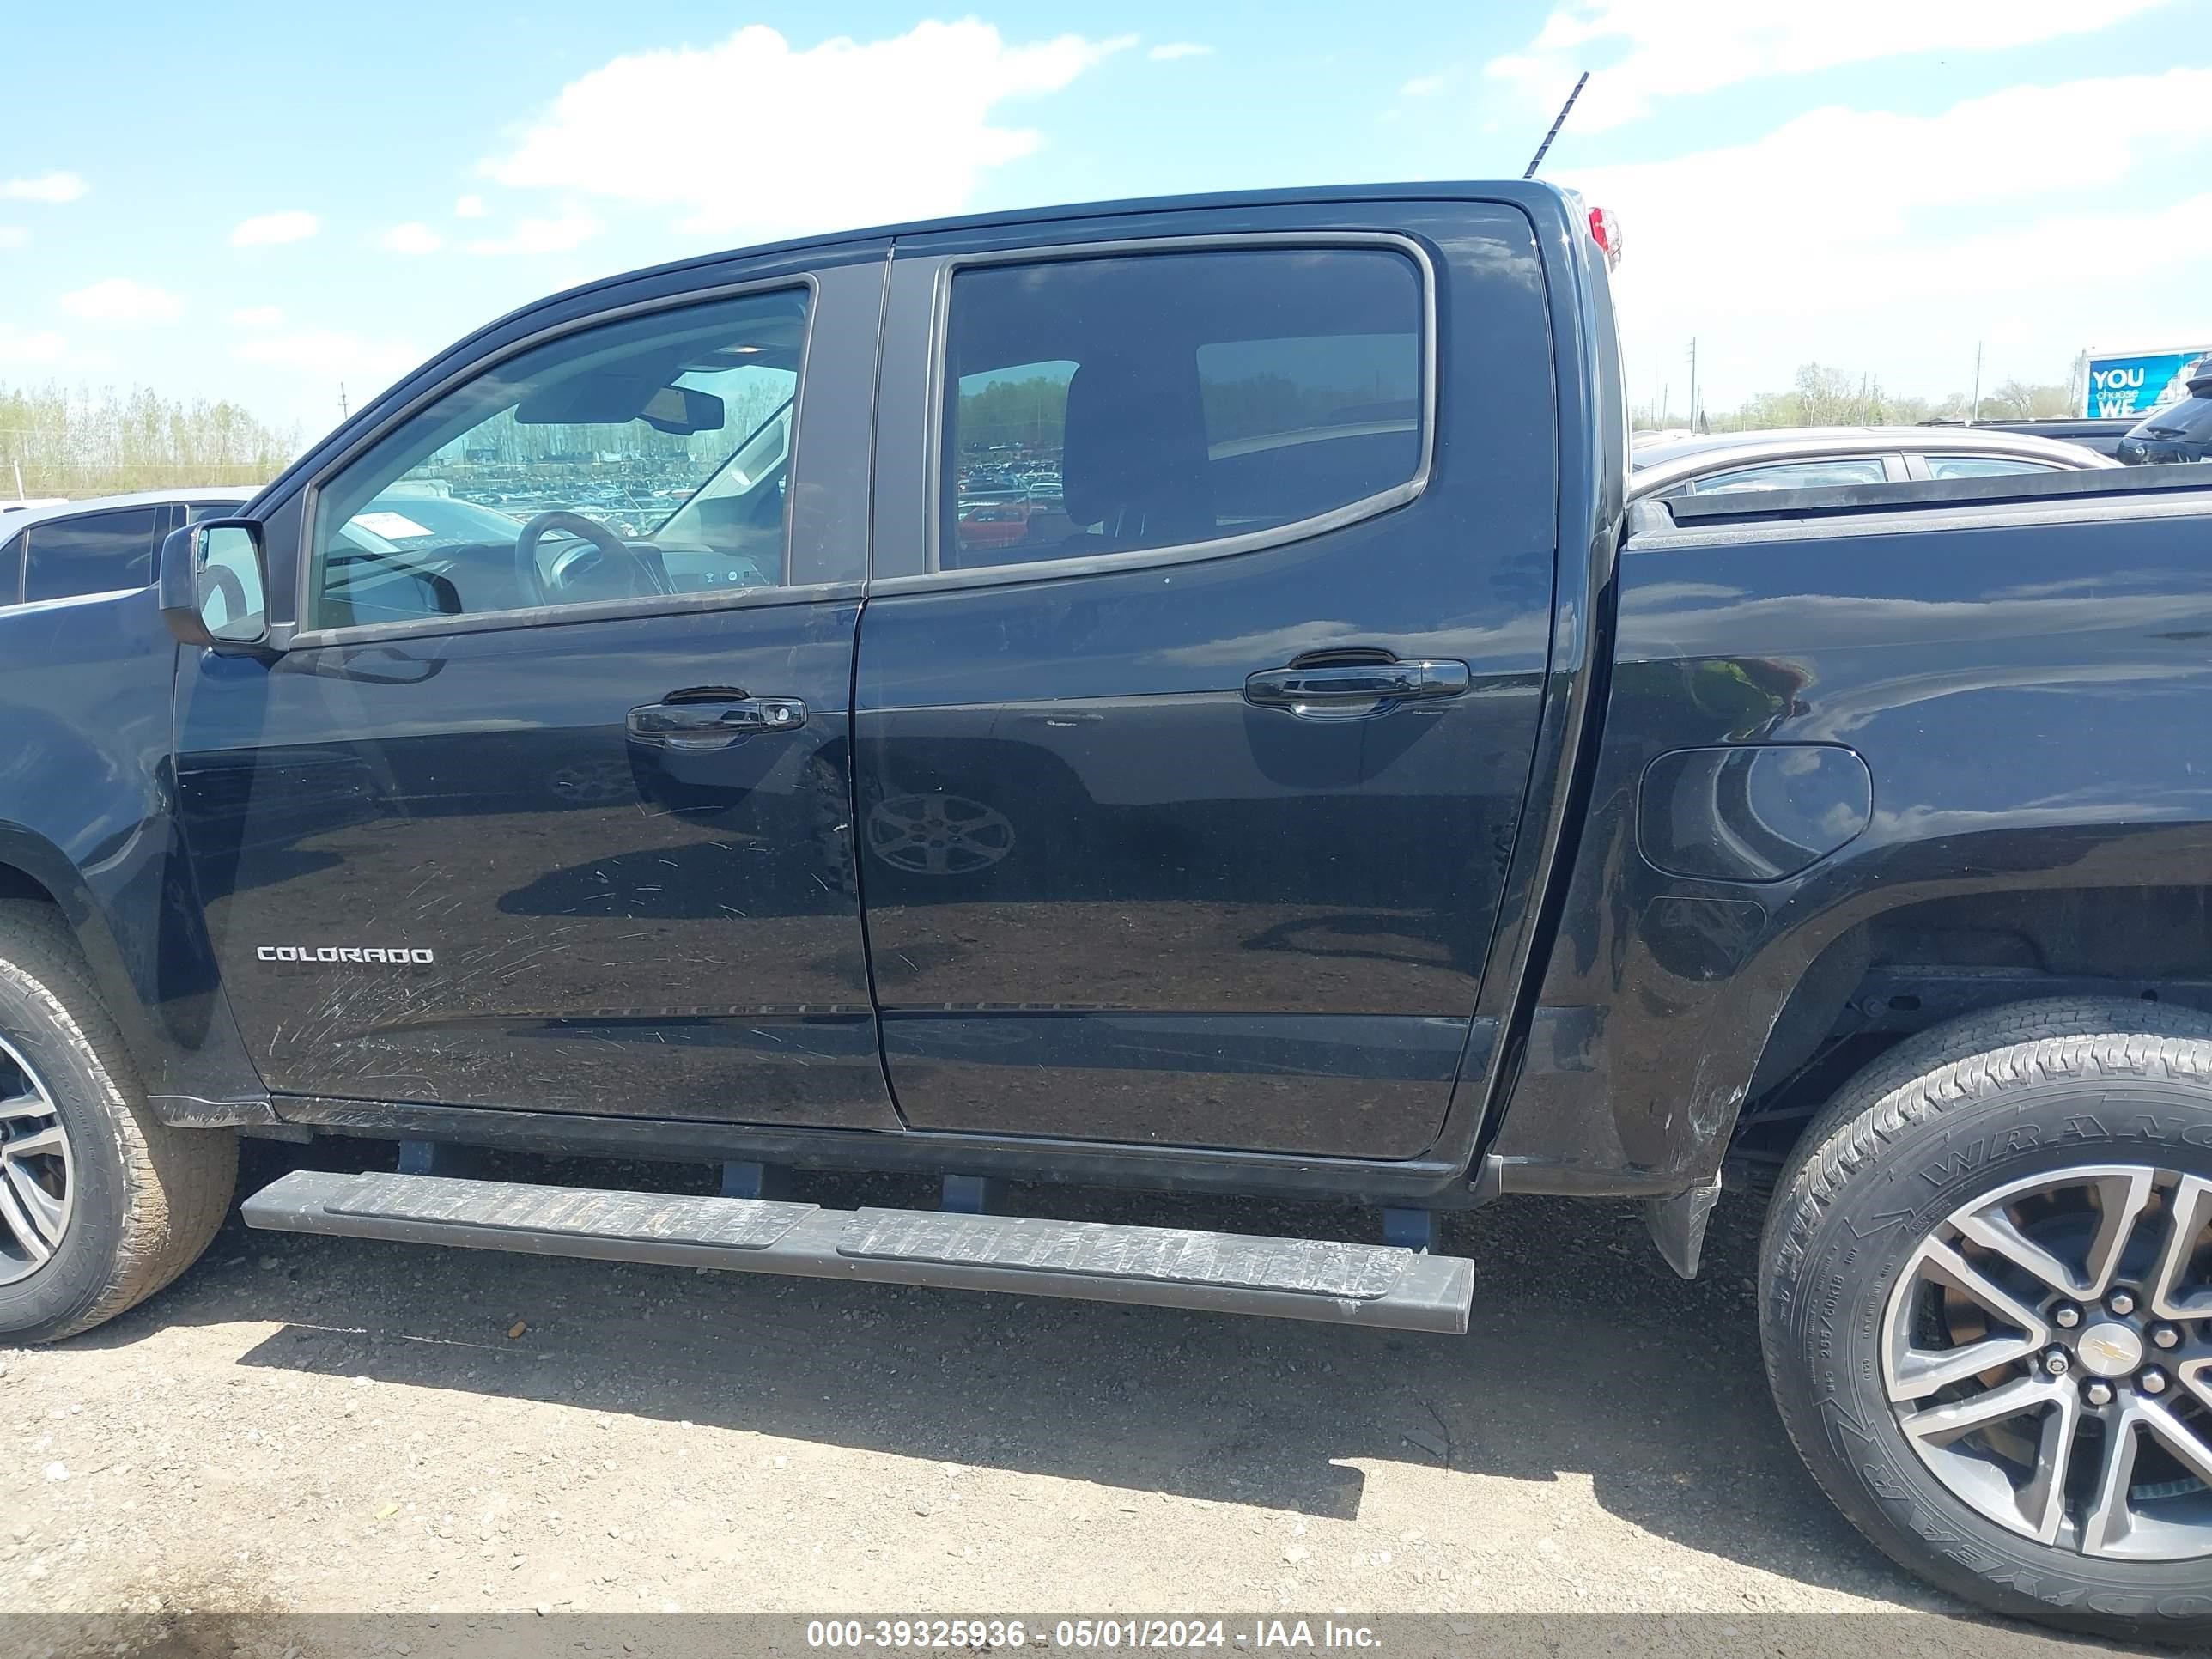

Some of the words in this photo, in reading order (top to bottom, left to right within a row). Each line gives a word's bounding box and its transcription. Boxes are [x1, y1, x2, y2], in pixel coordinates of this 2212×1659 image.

[2093, 368, 2144, 389] YOU
[2096, 390, 2139, 400] choose
[2098, 400, 2136, 417] WE
[257, 946, 434, 964] COLORADO
